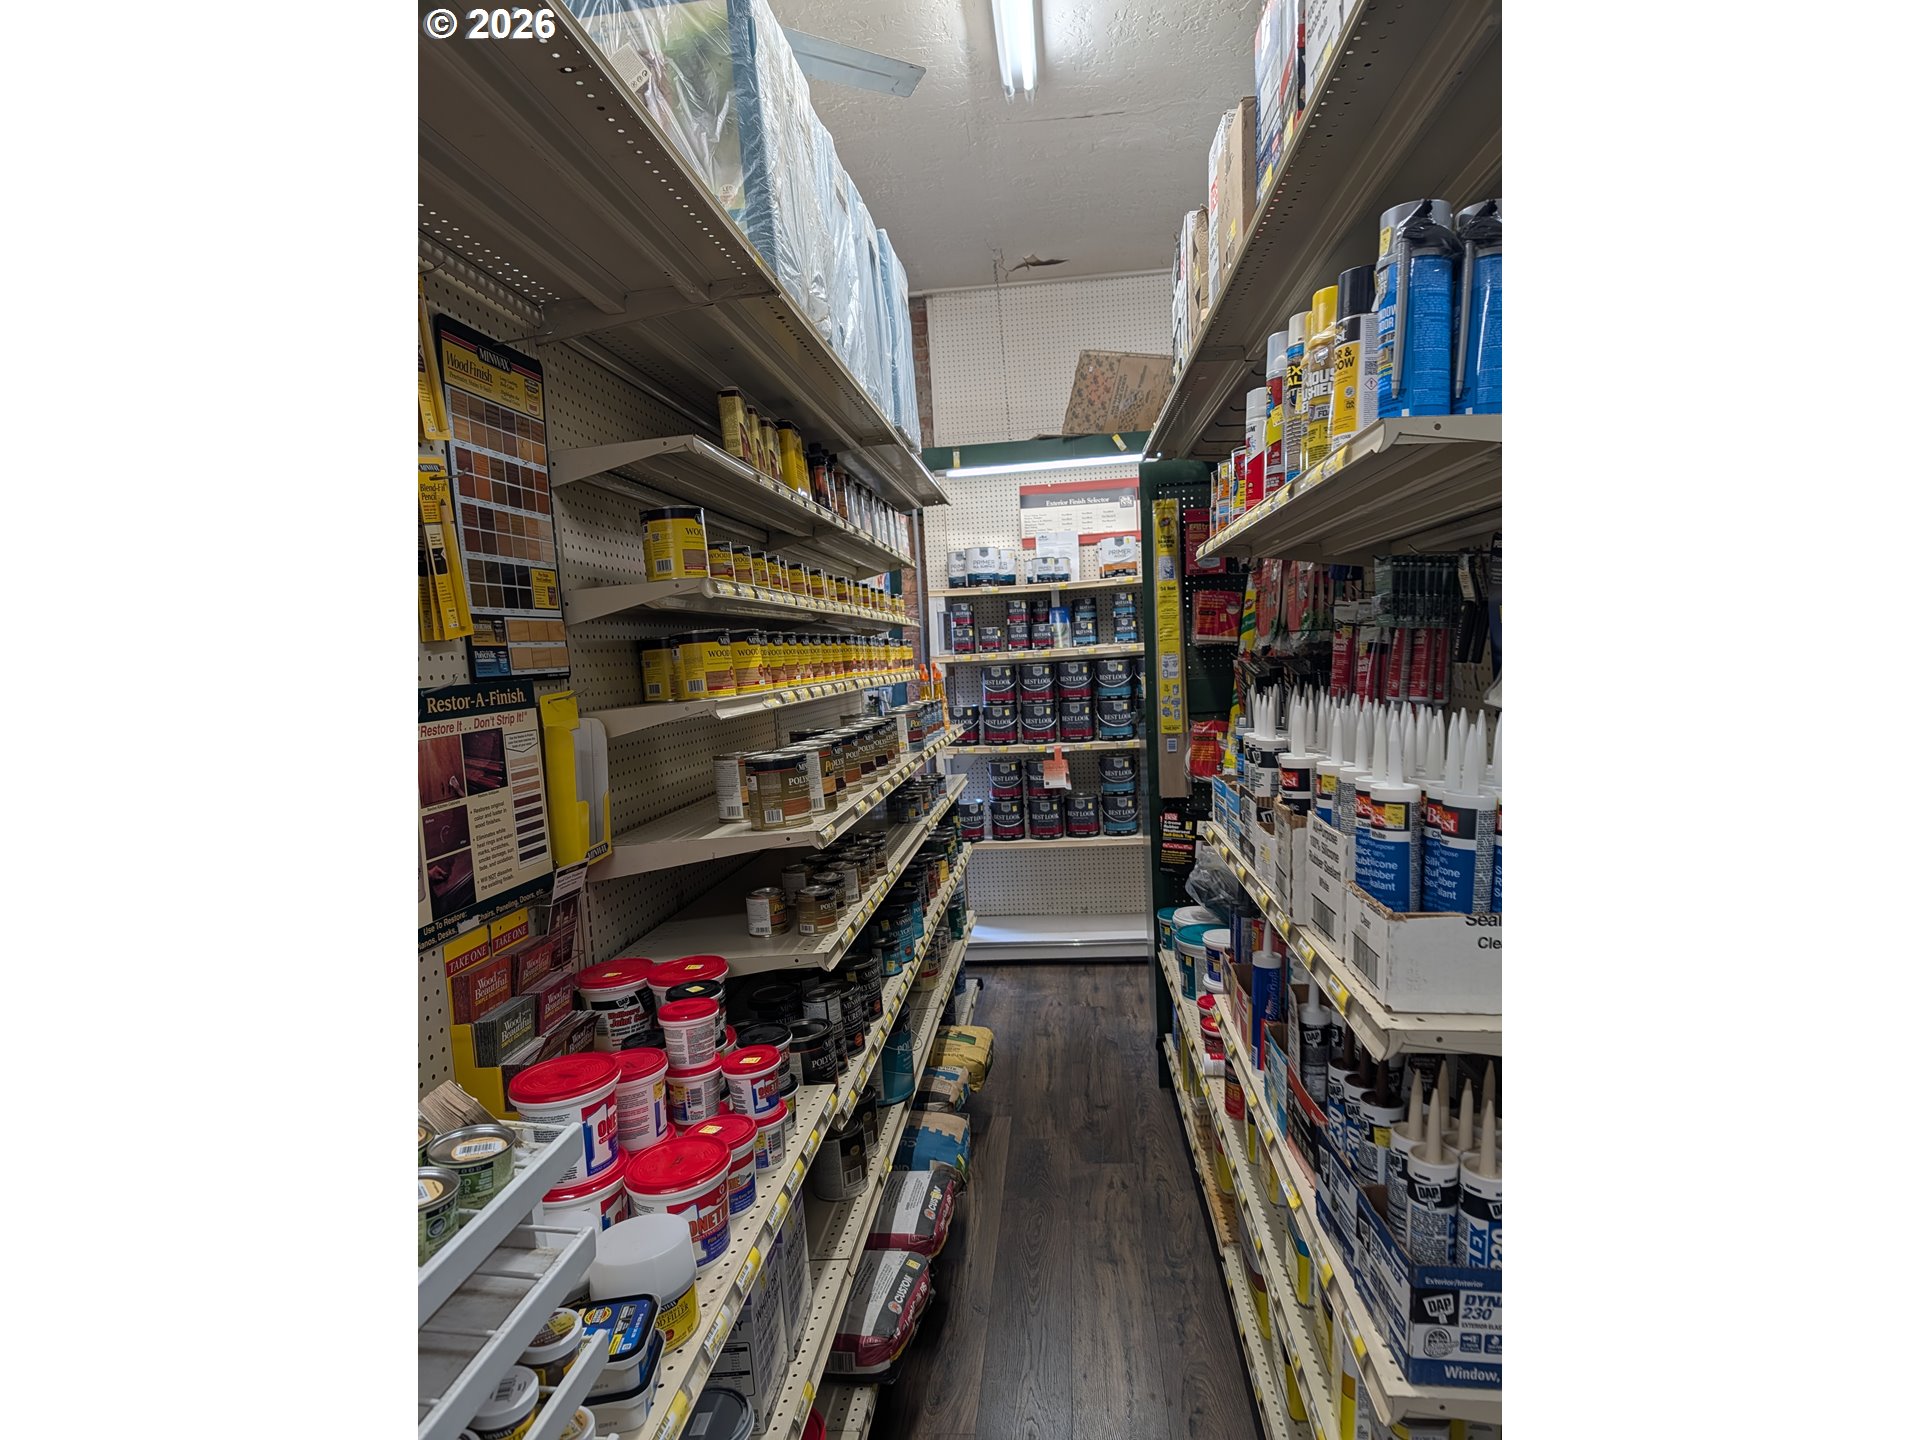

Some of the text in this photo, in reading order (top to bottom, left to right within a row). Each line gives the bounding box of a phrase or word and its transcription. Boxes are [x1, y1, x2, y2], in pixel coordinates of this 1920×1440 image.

[446, 350, 493, 384] Wood Finish
[480, 347, 510, 372] MINWAX
[1045, 499, 1069, 507] Exterior
[1069, 497, 1086, 505] Finish
[474, 714, 495, 730] Don't
[496, 713, 515, 727] Strip
[473, 805, 490, 814] Restores
[474, 814, 484, 822] color
[475, 821, 486, 829] wood
[476, 831, 495, 841] Eliminates
[488, 872, 497, 880] NOT
[423, 911, 467, 936] Use To Restore:
[494, 924, 528, 950] TAKE ONE
[449, 944, 488, 974] TAKE ONE
[474, 974, 508, 1000] Beautiful
[477, 972, 497, 990] Wood
[547, 987, 563, 1003] Wood
[618, 997, 629, 1005] DAP
[608, 1006, 641, 1019] Wallboard
[501, 1014, 532, 1042] Beautiful
[504, 1012, 522, 1031] Wood
[610, 1016, 632, 1028] Joint
[1305, 1031, 1320, 1041] DAP
[1419, 1185, 1440, 1198] DAP
[893, 1273, 914, 1304] CUSTOM
[1424, 1276, 1484, 1288] Exterior/Interior
[1427, 1297, 1452, 1313] DAP
[667, 1304, 690, 1324] FILLER
[1462, 1307, 1492, 1320] 230
[1443, 1364, 1501, 1383] Window,
